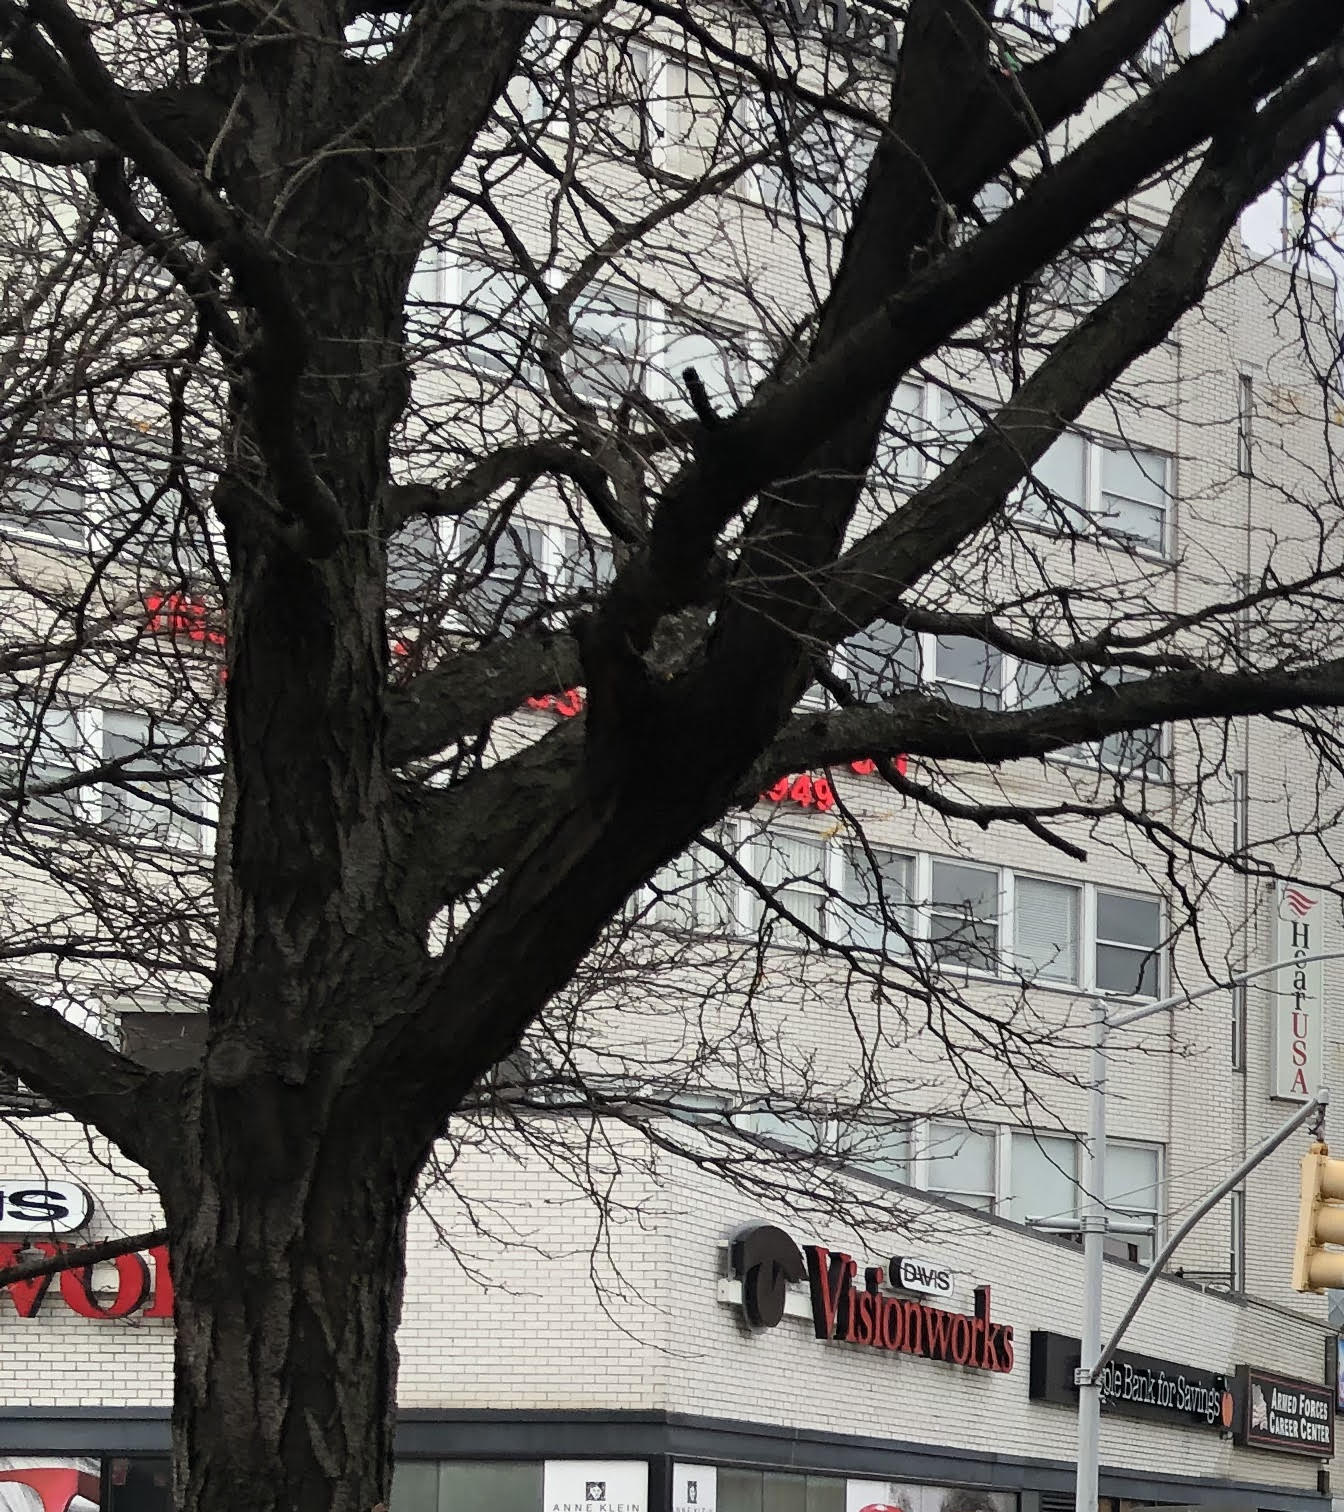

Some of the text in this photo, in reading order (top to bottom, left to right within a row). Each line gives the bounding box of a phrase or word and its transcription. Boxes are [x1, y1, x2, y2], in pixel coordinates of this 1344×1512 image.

[903, 1262, 950, 1291] DAVIS
[802, 1245, 1014, 1373] Visionworks
[1123, 1363, 1156, 1404] Bank
[1157, 1370, 1176, 1408] for
[1177, 1375, 1221, 1424] Savings
[1299, 1393, 1328, 1420] FORCES
[1269, 1410, 1330, 1443] CAREER CENTER
[552, 1503, 640, 1512] ANNE KLEIN
